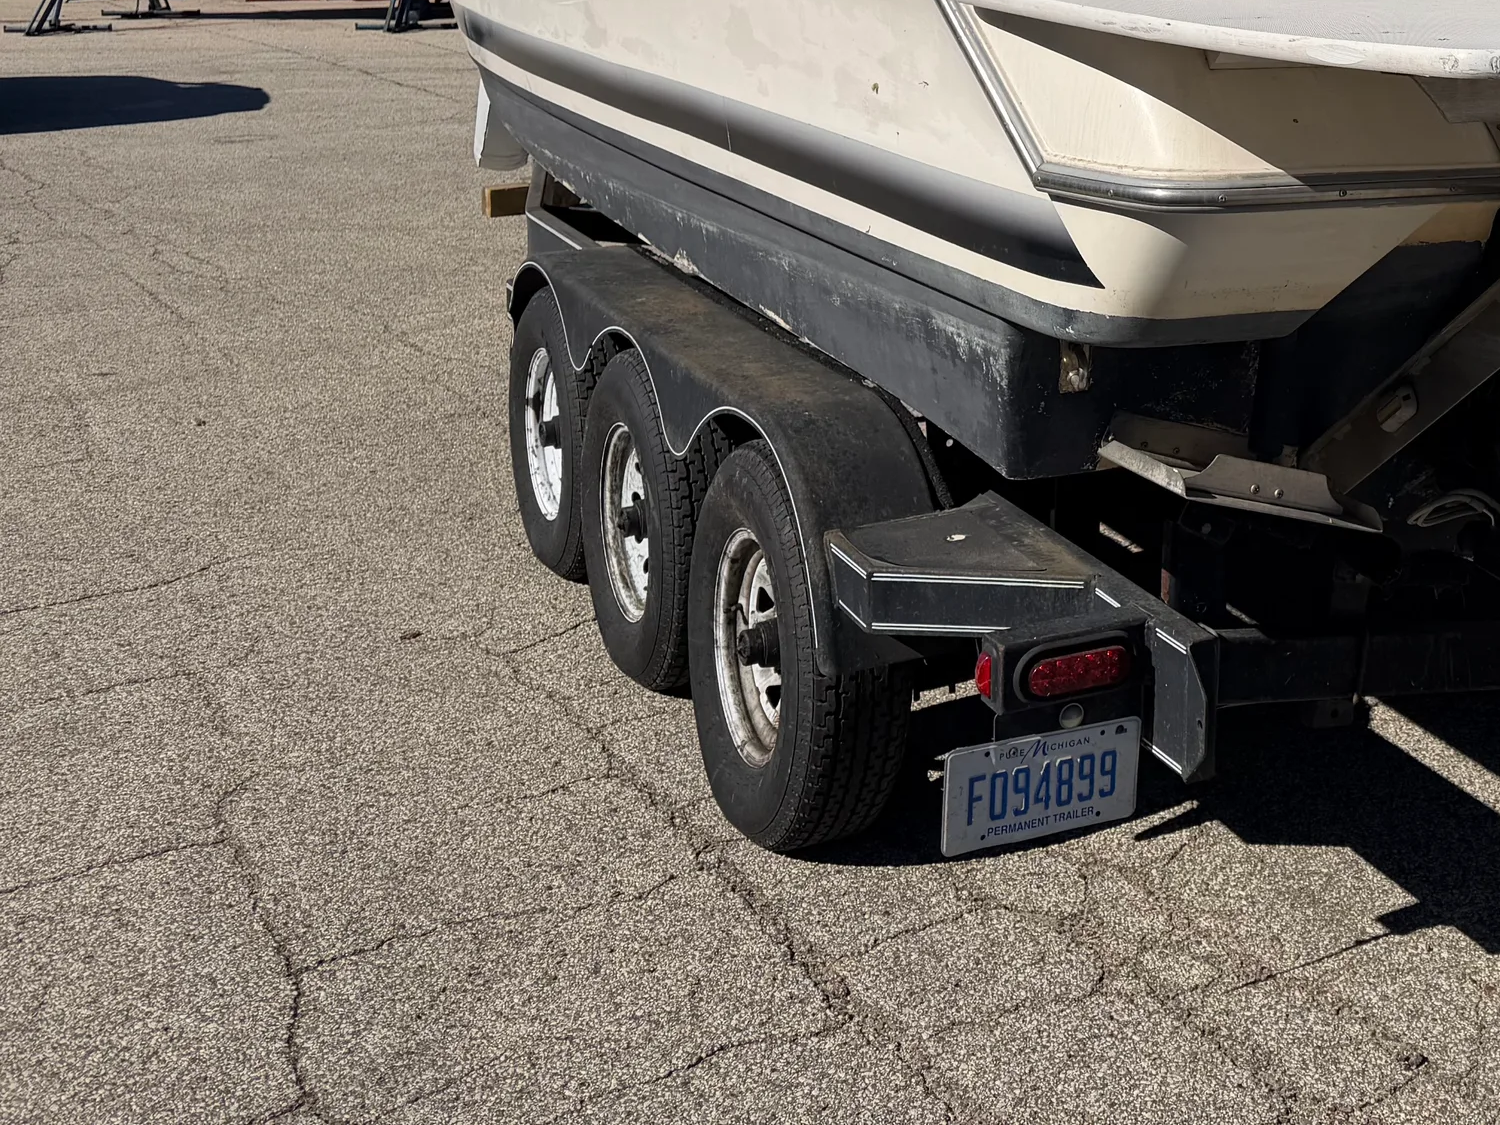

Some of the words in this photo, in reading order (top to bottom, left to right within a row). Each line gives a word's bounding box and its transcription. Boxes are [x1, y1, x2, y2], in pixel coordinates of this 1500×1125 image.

[966, 748, 1118, 827] F094899
[986, 815, 1051, 838] PERMANENT
[1053, 805, 1095, 826] TRAILER
